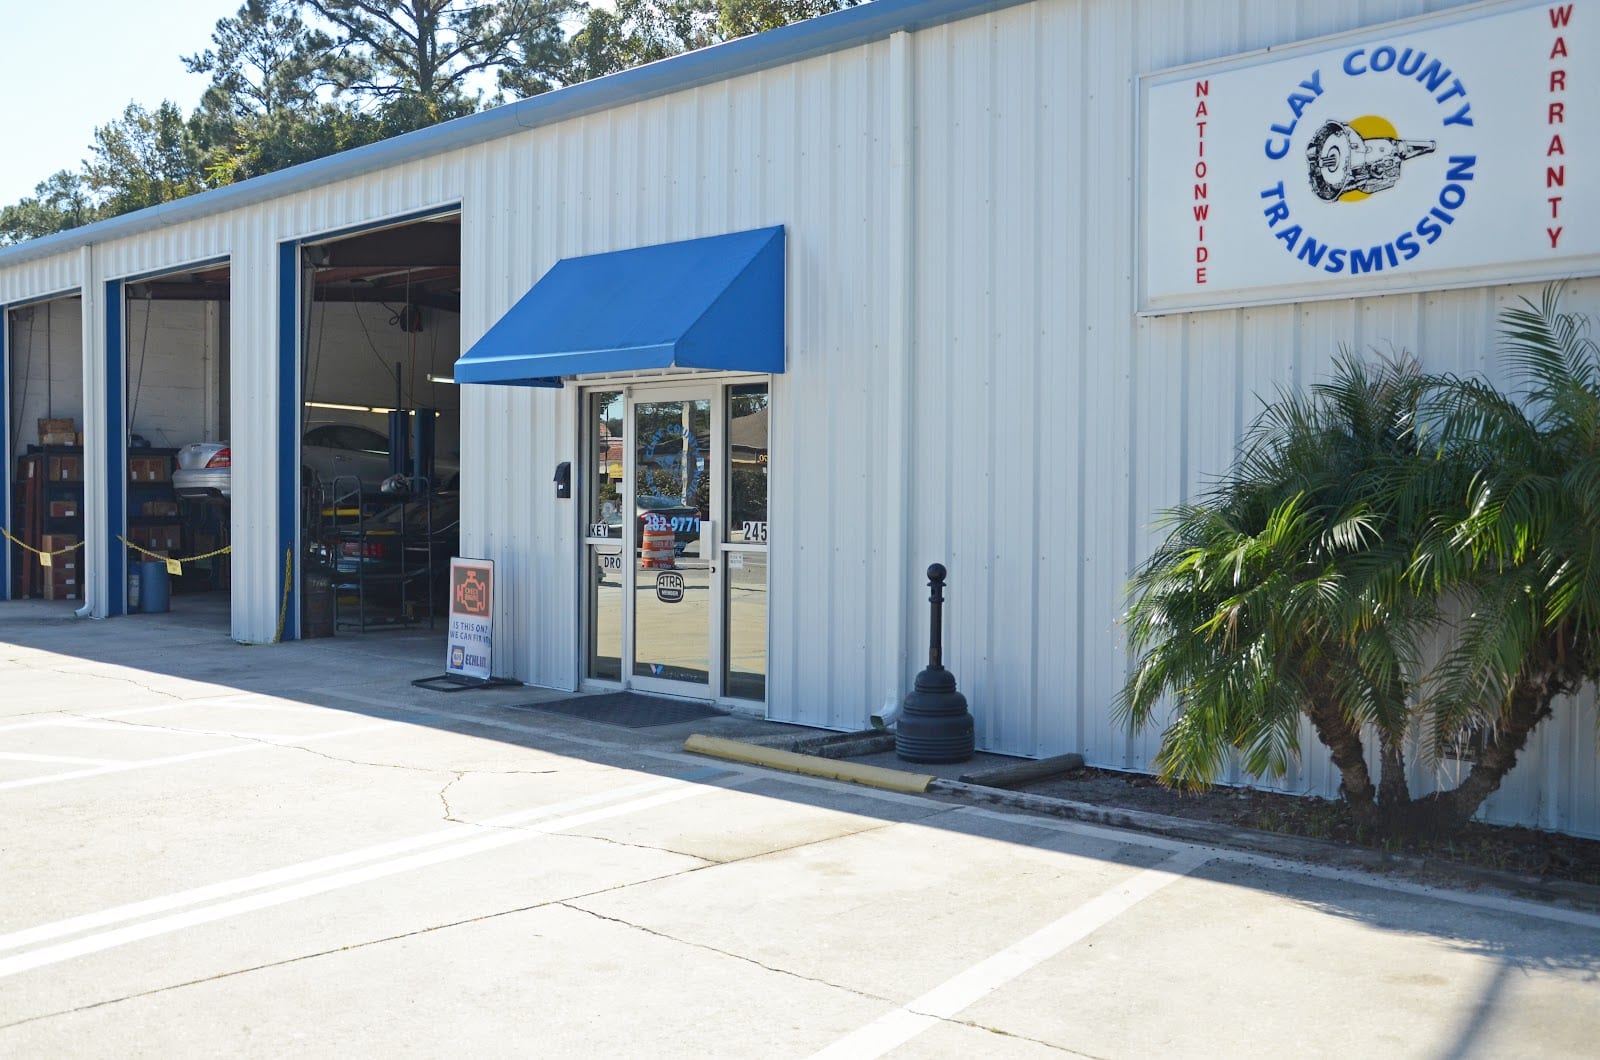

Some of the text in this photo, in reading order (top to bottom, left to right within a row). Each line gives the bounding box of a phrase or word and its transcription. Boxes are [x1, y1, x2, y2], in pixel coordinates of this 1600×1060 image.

[1265, 46, 1474, 160] CLAY COUNTY
[1546, 5, 1573, 249] WARRANTY
[1193, 80, 1210, 284] NATIONWIDE
[1260, 154, 1477, 275] TRANSMISSION
[450, 631, 459, 639] WE
[459, 632, 472, 641] CAN
[460, 621, 475, 632] THIS
[658, 575, 682, 588] ATRA
